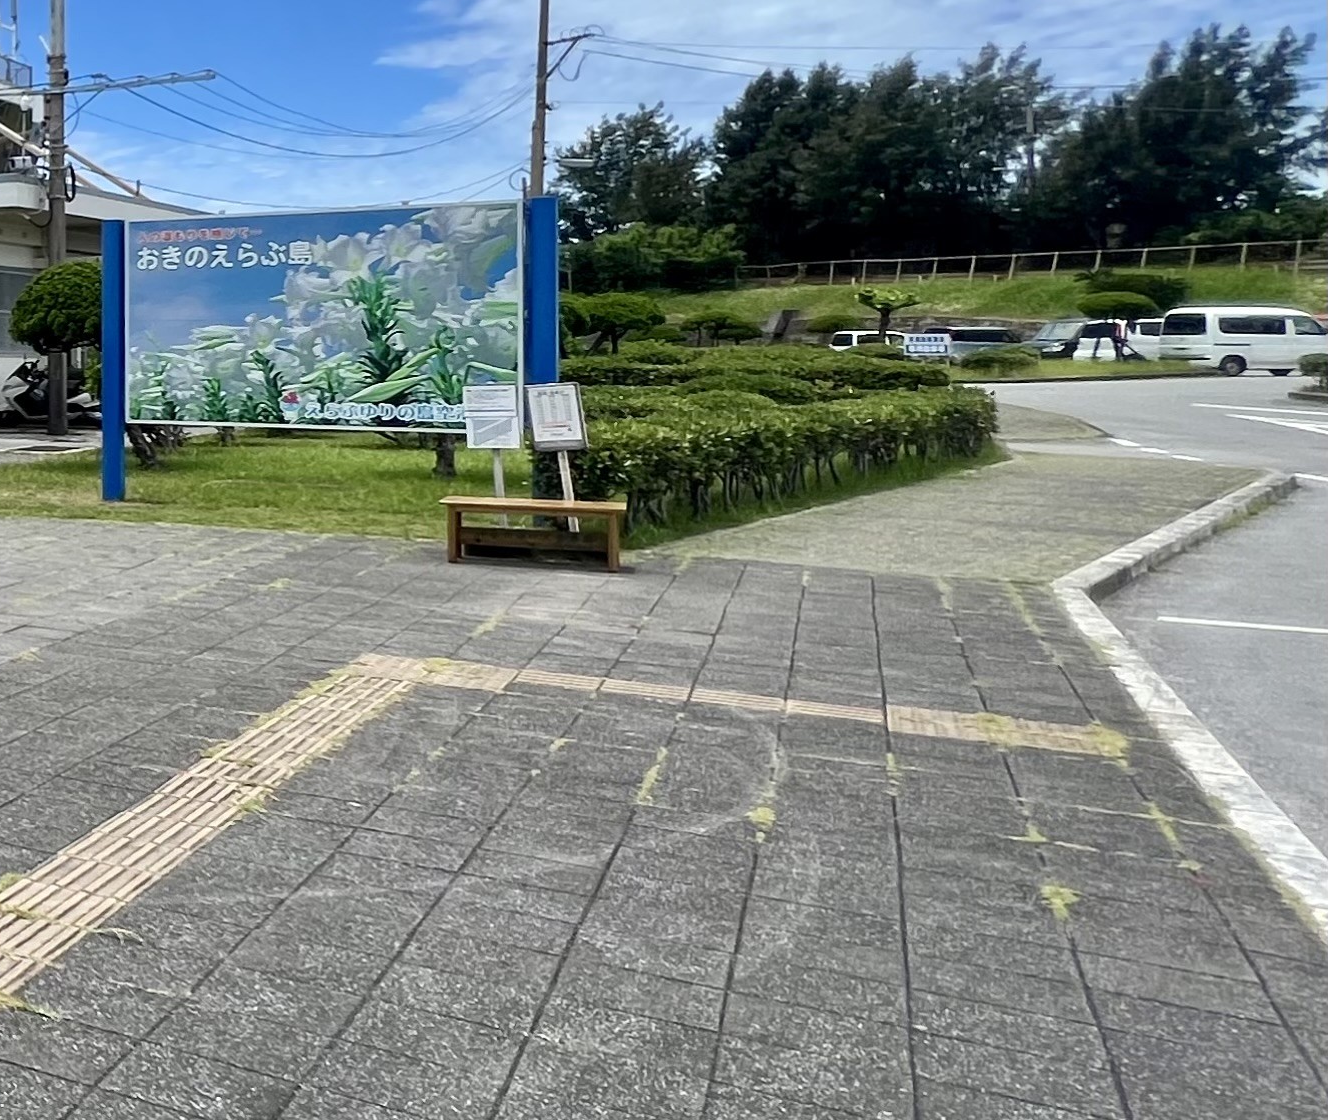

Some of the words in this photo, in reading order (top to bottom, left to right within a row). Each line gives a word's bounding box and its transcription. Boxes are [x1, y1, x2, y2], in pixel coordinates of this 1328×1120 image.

[136, 241, 313, 271] おきのえらぶ島
